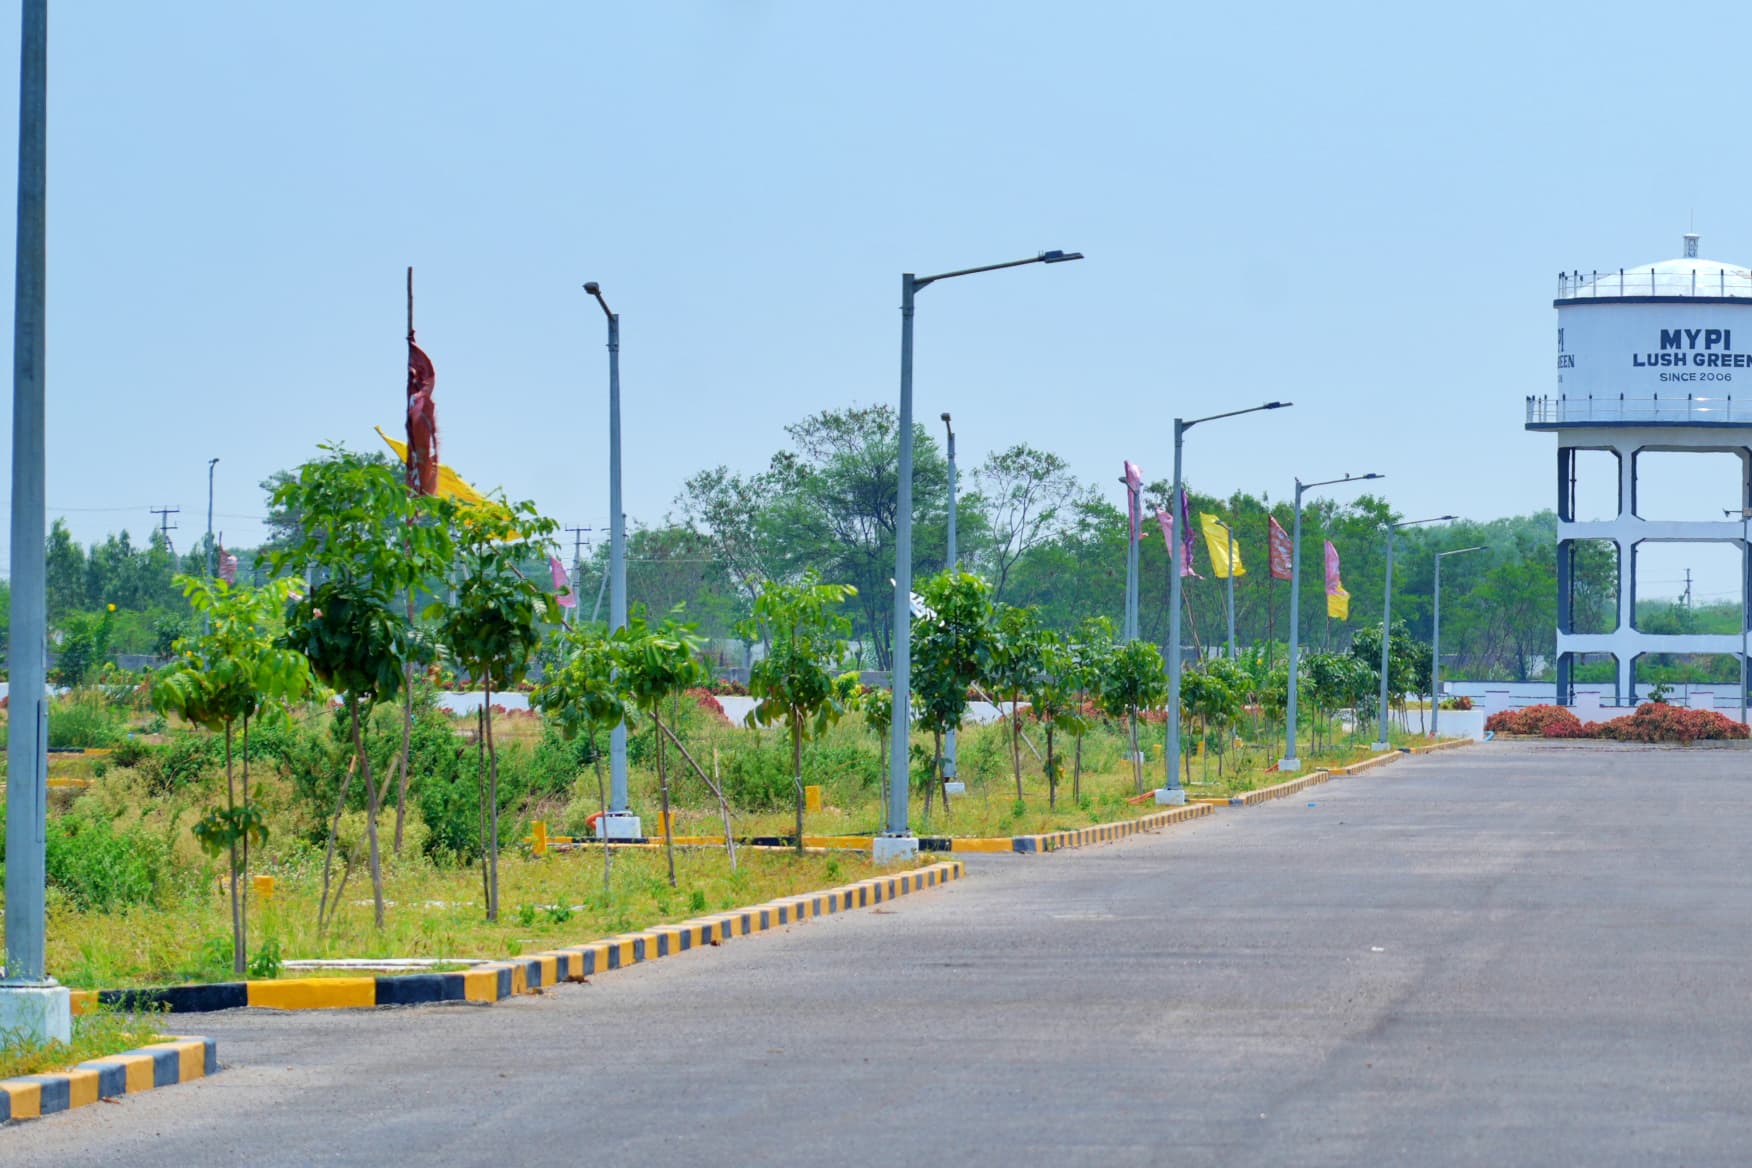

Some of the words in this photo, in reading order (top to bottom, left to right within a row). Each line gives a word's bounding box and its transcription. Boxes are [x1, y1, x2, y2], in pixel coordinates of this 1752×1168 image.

[1660, 329, 1731, 351] MYPI
[1633, 352, 1687, 367] LUSH
[1660, 372, 1697, 382] SINCE
[1700, 372, 1732, 382] 2006
